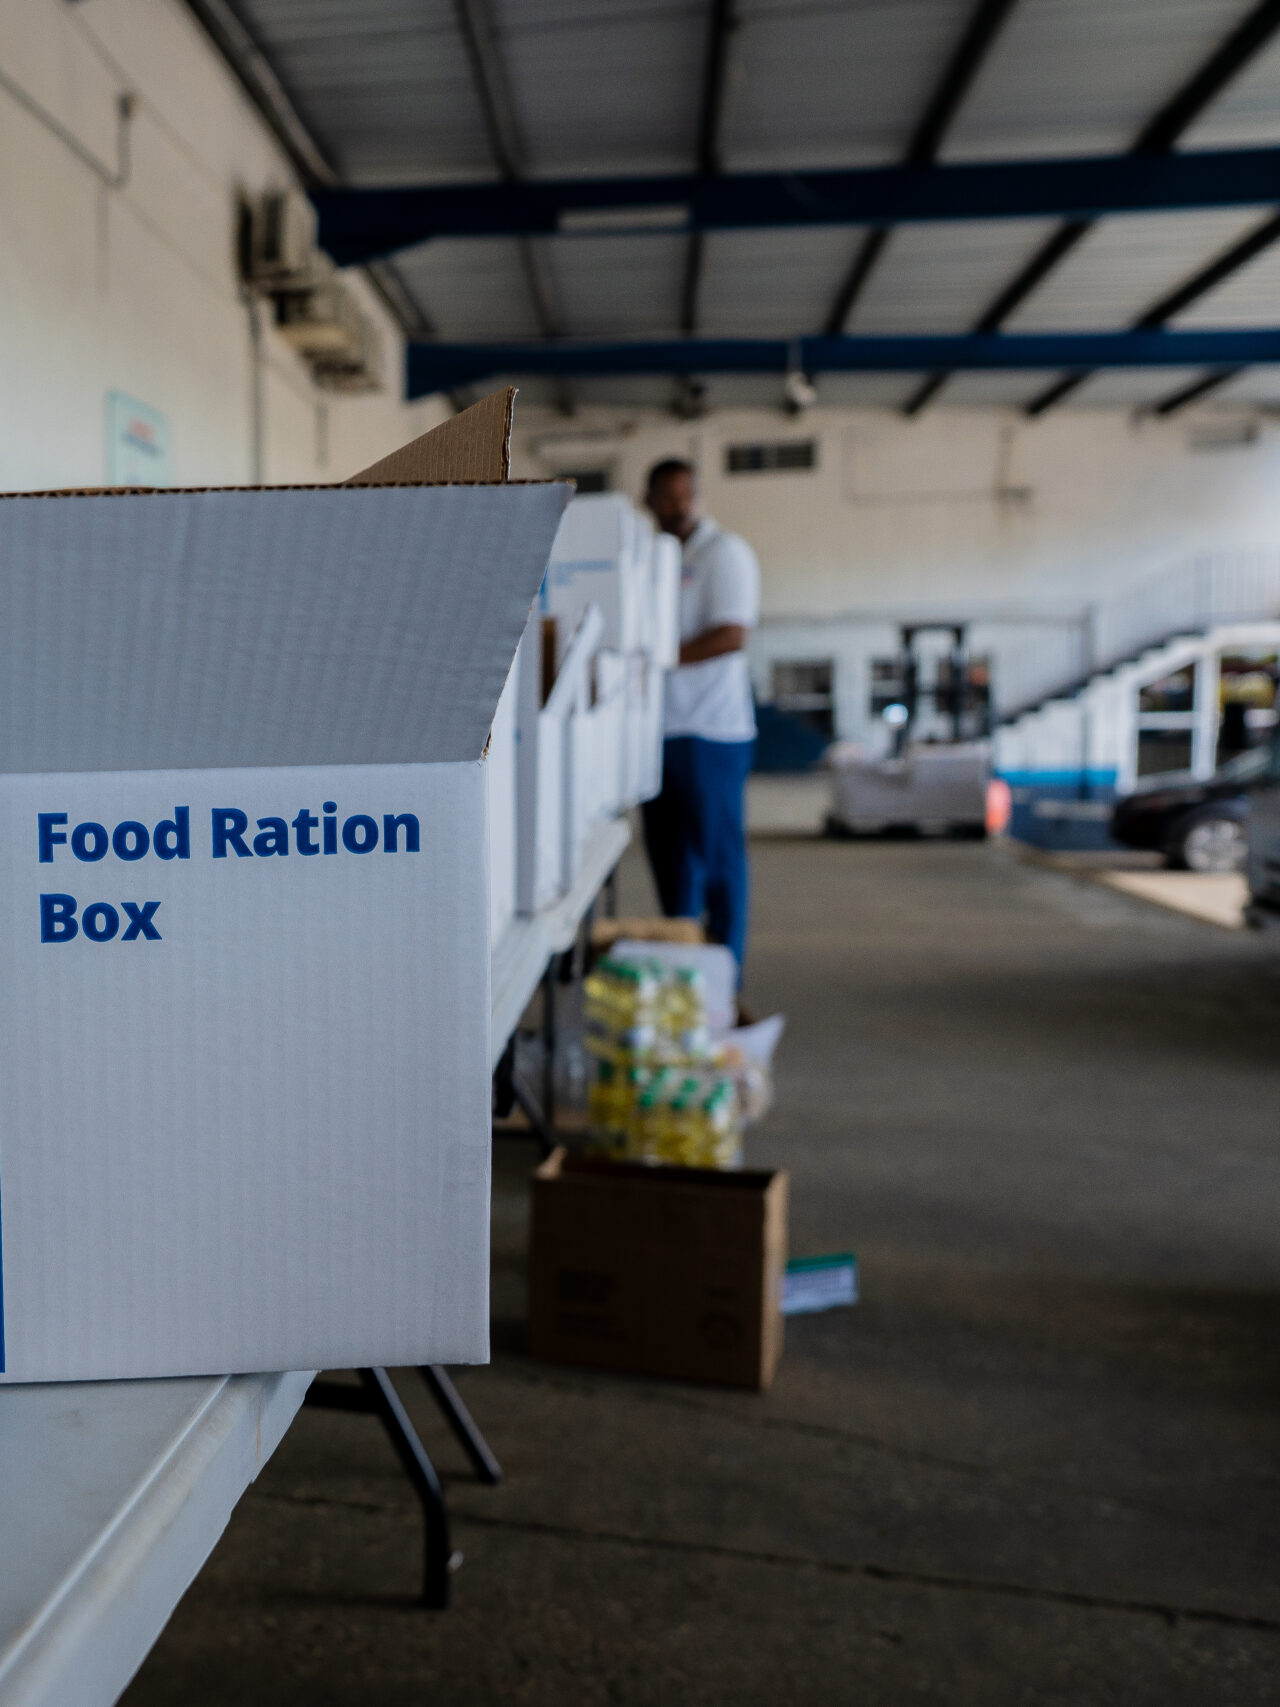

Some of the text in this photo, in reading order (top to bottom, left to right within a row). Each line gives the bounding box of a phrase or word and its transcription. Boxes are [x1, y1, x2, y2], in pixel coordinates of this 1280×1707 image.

[37, 800, 420, 863] Food Ration
[39, 893, 162, 943] Box
